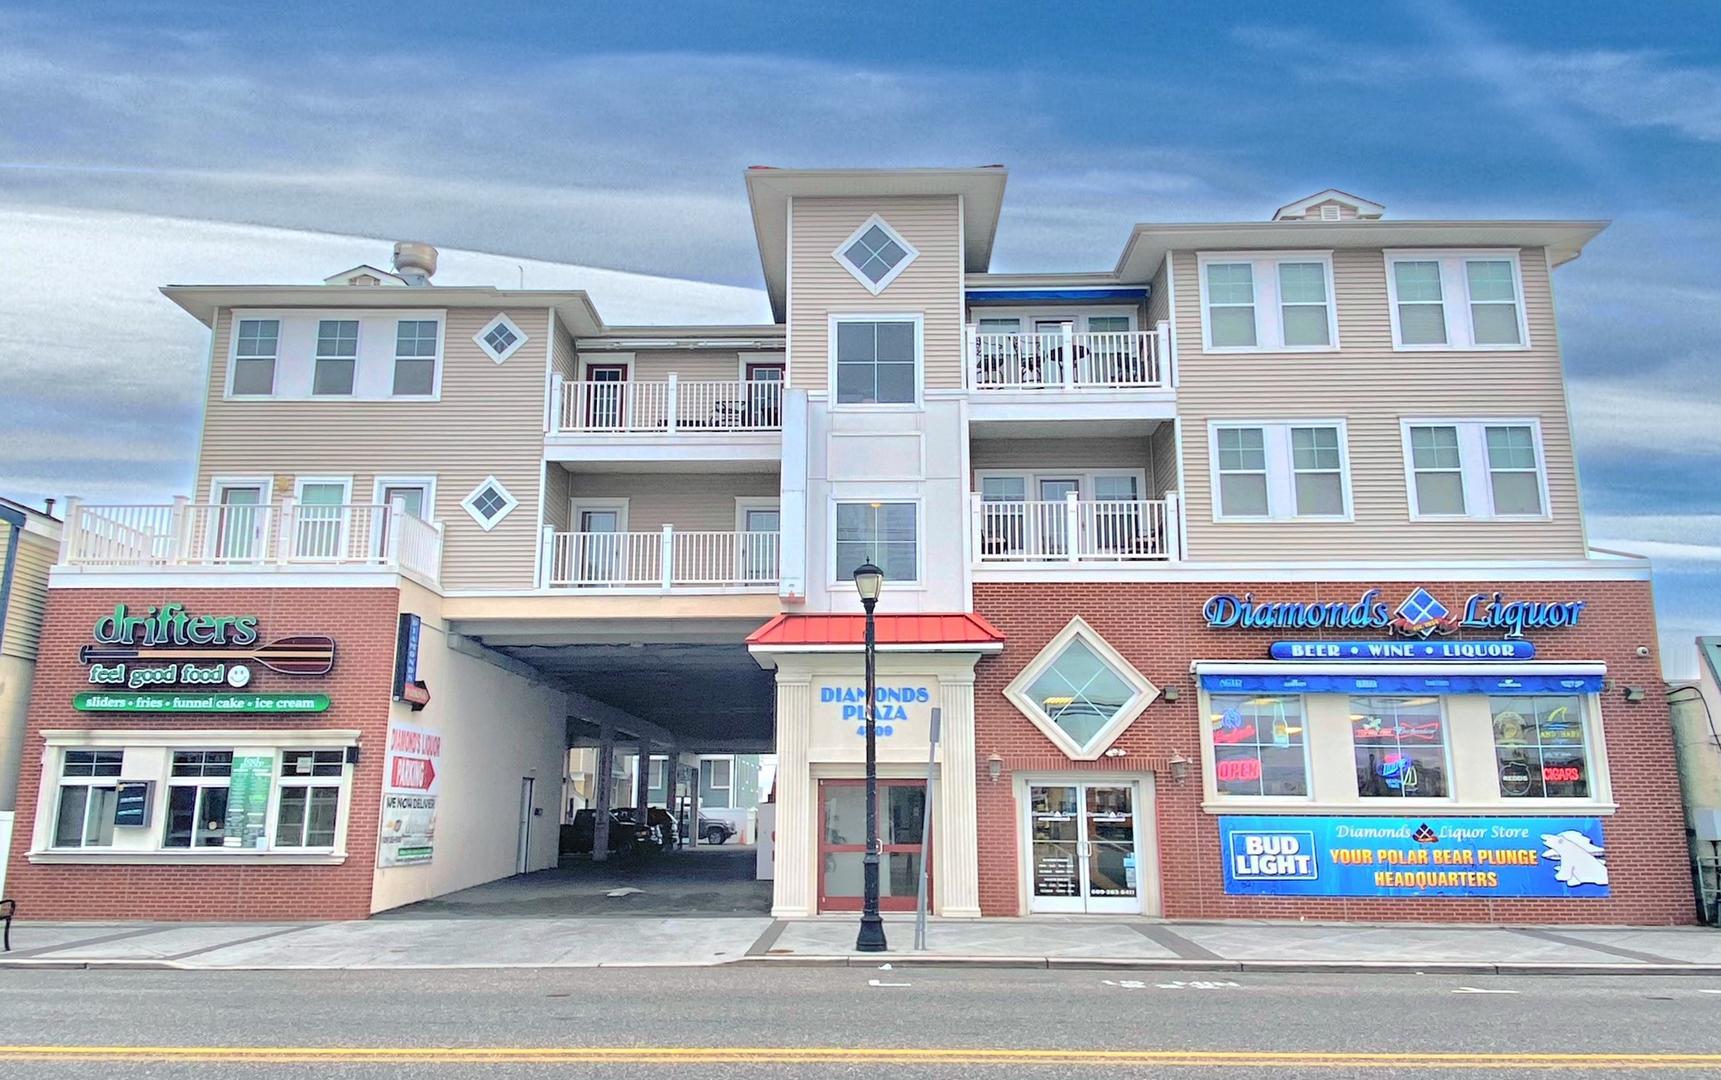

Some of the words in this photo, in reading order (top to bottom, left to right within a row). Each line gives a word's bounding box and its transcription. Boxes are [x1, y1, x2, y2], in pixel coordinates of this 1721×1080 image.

[1203, 589, 1392, 627] Diamonds
[1459, 592, 1586, 639] Liquor
[93, 603, 257, 645] drifters
[1291, 645, 1346, 657] BEER
[1367, 645, 1416, 657] WINE
[1442, 645, 1515, 658] LIQUOR
[89, 664, 125, 683] feel
[128, 664, 178, 688] good
[180, 664, 224, 684] food
[86, 697, 127, 708] sliders
[135, 697, 162, 708] fries
[172, 697, 213, 708] funnel
[215, 697, 246, 708] cake
[255, 697, 273, 708] ice
[276, 698, 315, 708] cream
[821, 687, 929, 703] DIAMONDS
[843, 704, 908, 721] PLAZA
[856, 725, 894, 737] 400
[1219, 761, 1259, 782] OPEN
[1543, 767, 1580, 783] CIGARS
[386, 797, 396, 808] WE
[397, 797, 412, 809] NOW
[413, 798, 435, 809] DELIVER
[1336, 824, 1411, 839] Diamonds
[1440, 826, 1488, 841] Liquor
[1490, 826, 1529, 839] Store
[1245, 836, 1300, 855] BUD
[1236, 854, 1311, 876] LIGHT
[1330, 849, 1373, 865] YOUR
[1378, 849, 1428, 865] POLAR
[1433, 849, 1474, 865] BEAR
[1478, 849, 1538, 866] PLUNGE
[1374, 871, 1499, 888] HEADQUARTERS
